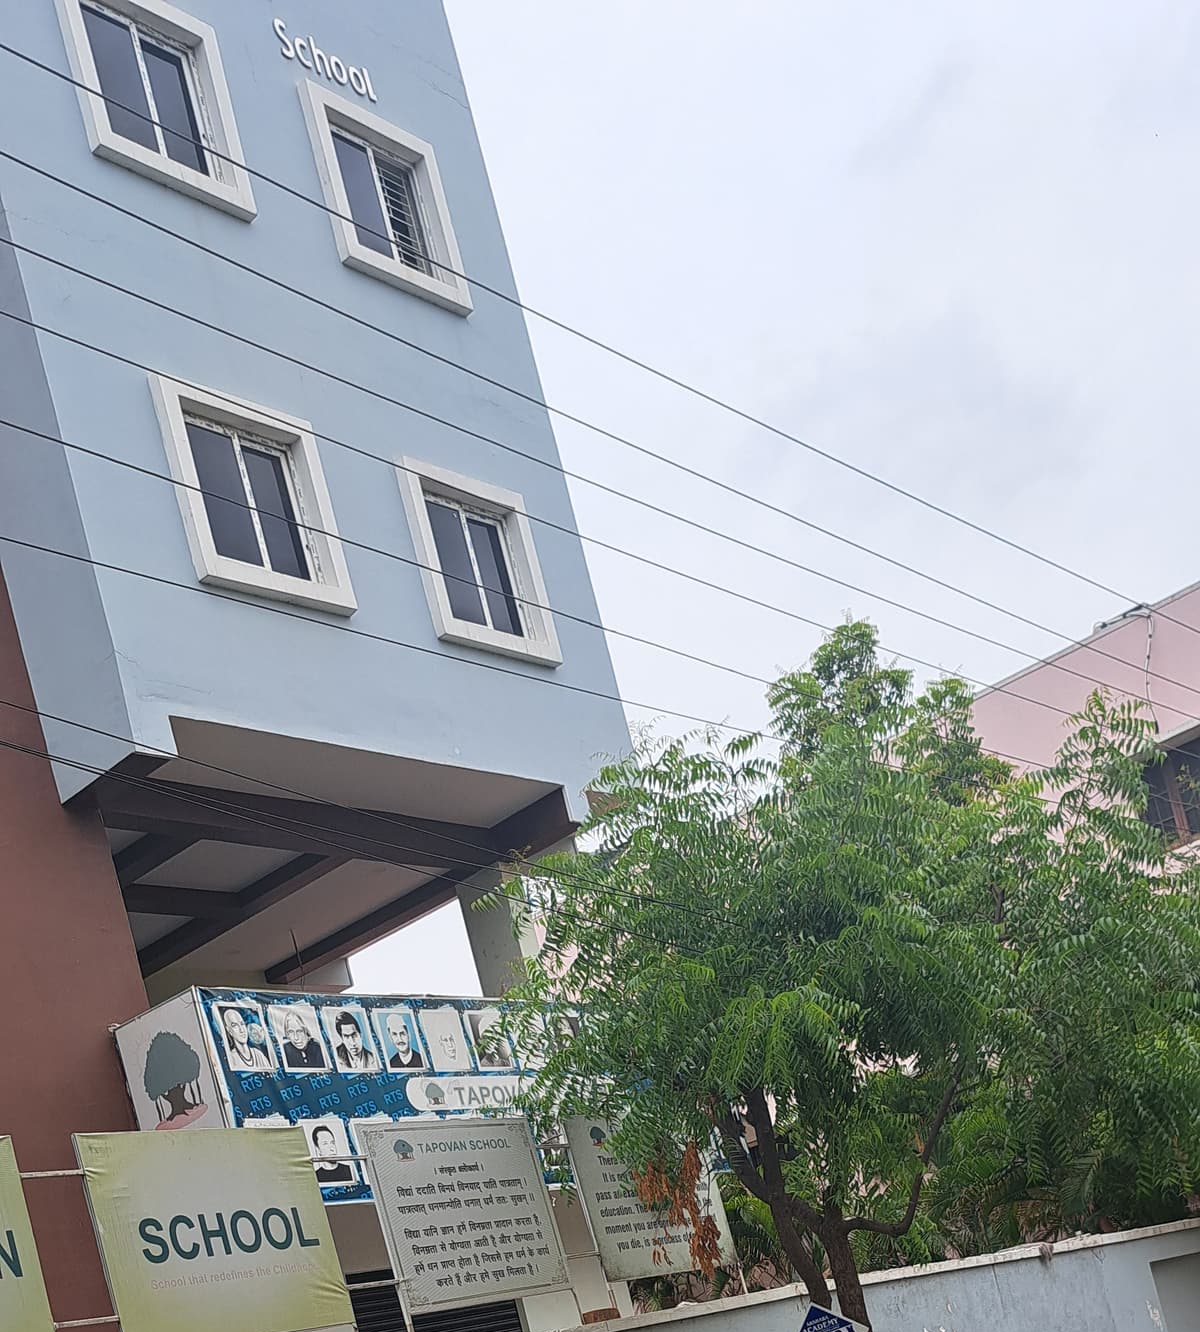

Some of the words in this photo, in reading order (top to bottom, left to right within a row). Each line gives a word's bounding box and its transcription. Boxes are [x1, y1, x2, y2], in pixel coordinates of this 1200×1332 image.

[273, 18, 377, 103] School
[241, 1076, 262, 1092] RTS
[311, 1075, 331, 1090] RTS
[348, 1082, 368, 1098] RTS
[280, 1085, 302, 1101] RTS
[320, 1093, 341, 1109] RTS
[384, 1089, 403, 1104] RTS
[250, 1096, 272, 1112] RTS
[356, 1101, 376, 1116] RTS
[289, 1104, 311, 1121] RTS
[417, 1140, 467, 1154] TAPOVAN
[469, 1138, 511, 1150] SCHOOL
[602, 1172, 609, 1182] It
[609, 1172, 616, 1182] is
[416, 1183, 436, 1195] ददाति
[457, 1181, 482, 1193] विनयाद्
[483, 1179, 497, 1190] याति
[595, 1191, 612, 1203] pass
[601, 1206, 633, 1218] education.
[138, 1207, 320, 1264] SCHOOL
[404, 1229, 421, 1240] विद्या
[423, 1225, 439, 1237] यानि
[514, 1216, 532, 1227] करता
[605, 1222, 632, 1235] moment
[634, 1221, 646, 1234] you
[439, 1243, 447, 1252] से
[449, 1240, 472, 1251] योग्यता
[474, 1236, 489, 1248] आती
[490, 1234, 497, 1248] है
[499, 1233, 512, 1245] और
[514, 1231, 536, 1242] योग्यता
[536, 1229, 544, 1240] से
[617, 1239, 630, 1252] you
[631, 1238, 644, 1249] die,
[644, 1236, 650, 1247] is
[427, 1261, 439, 1272] धन
[440, 1259, 456, 1270] प्राप्त
[457, 1255, 473, 1269] होता
[474, 1253, 481, 1267] है
[481, 1250, 502, 1264] जिससे
[504, 1250, 514, 1263] हम
[516, 1247, 526, 1259] धर्म
[528, 1247, 535, 1257] के
[537, 1245, 550, 1257] कार्य
[151, 1275, 187, 1290] School
[189, 1274, 208, 1286] that
[210, 1268, 254, 1282] redefines
[256, 1267, 272, 1278] the
[436, 1274, 454, 1288] करते
[463, 1271, 478, 1284] और
[492, 1271, 505, 1282] सुख
[506, 1265, 527, 1277] मिलता
[527, 1263, 535, 1276] है
